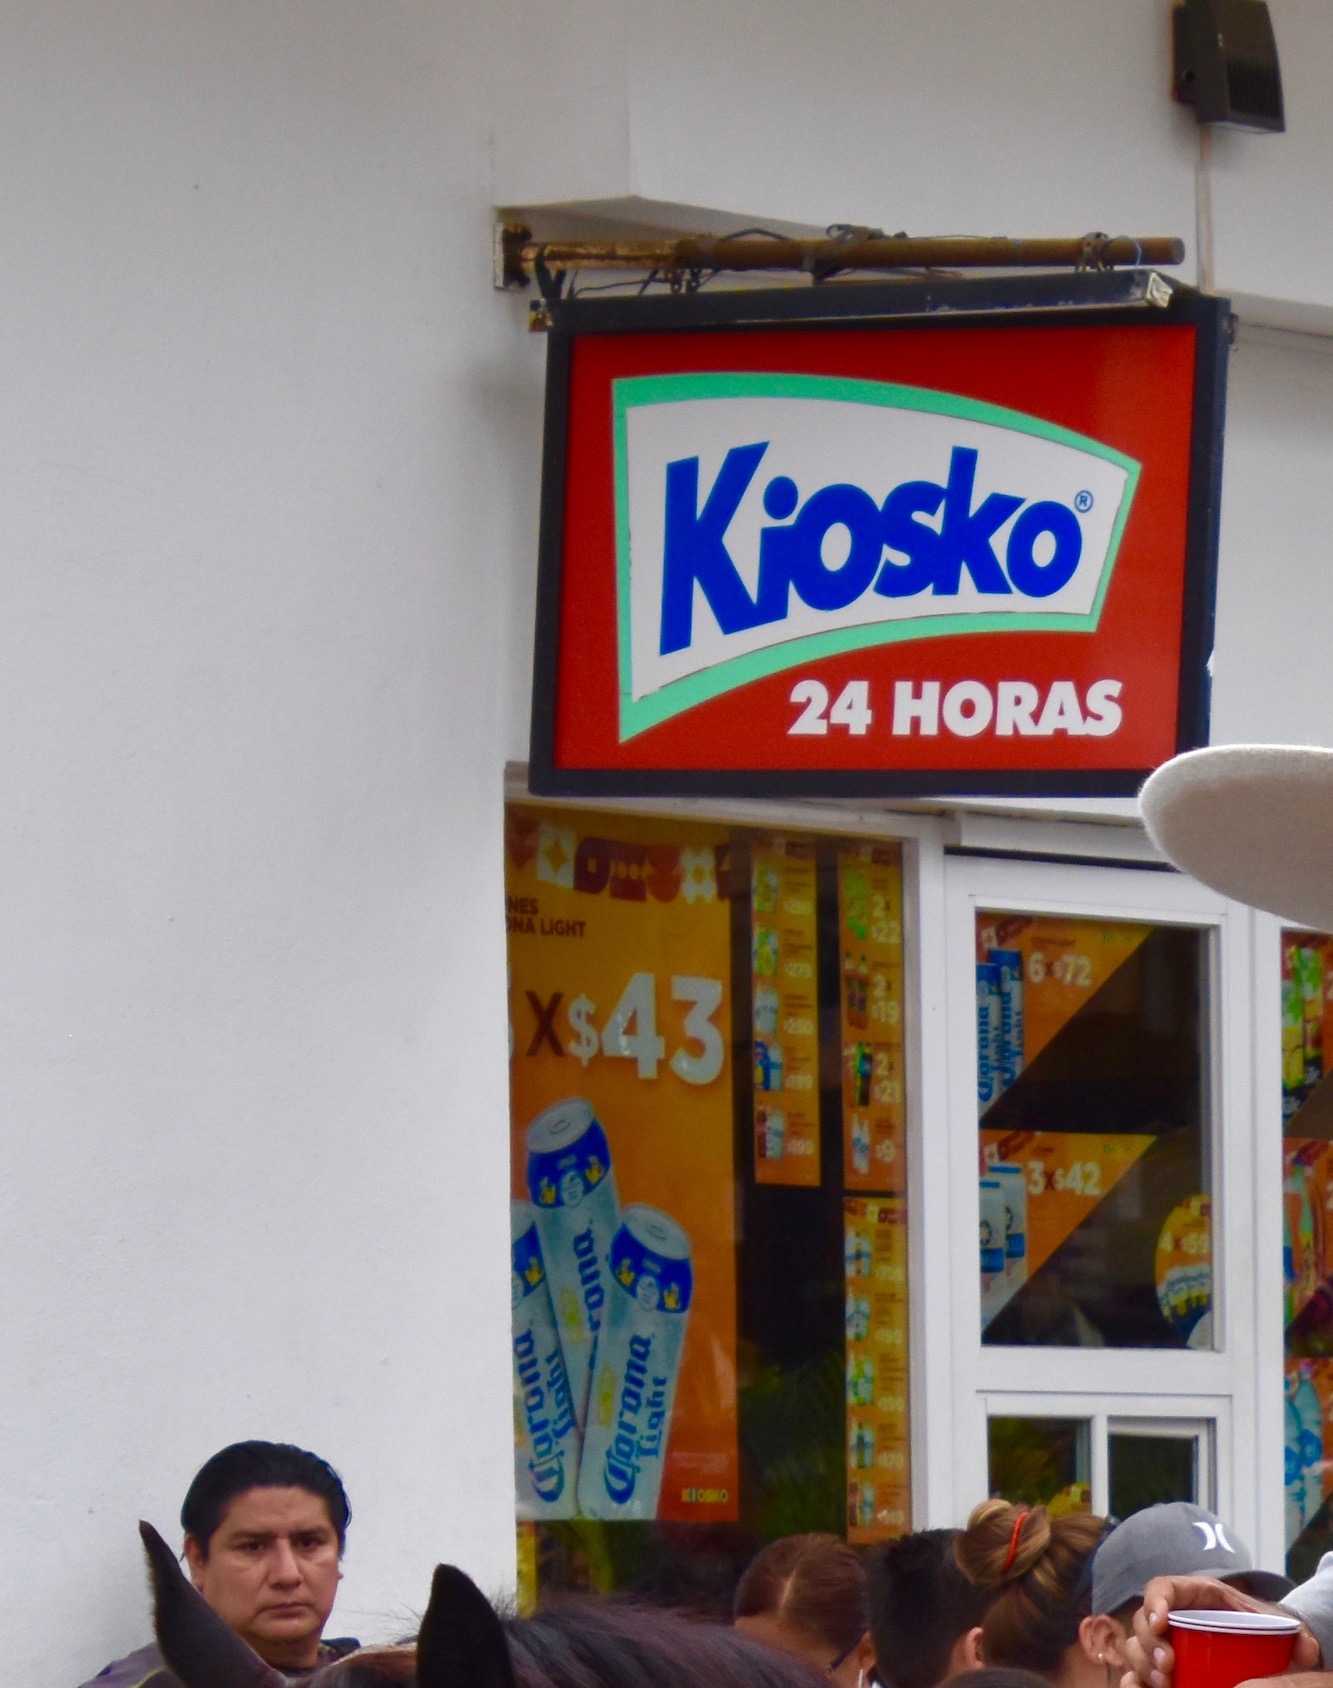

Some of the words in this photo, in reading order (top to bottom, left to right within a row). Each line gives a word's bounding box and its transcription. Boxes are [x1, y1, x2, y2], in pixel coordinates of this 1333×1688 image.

[659, 440, 1083, 656] Kiosko
[787, 679, 872, 736] 24
[891, 679, 1124, 737] HORAS
[540, 918, 586, 938] LIGHT
[602, 1333, 652, 1505] Corona
